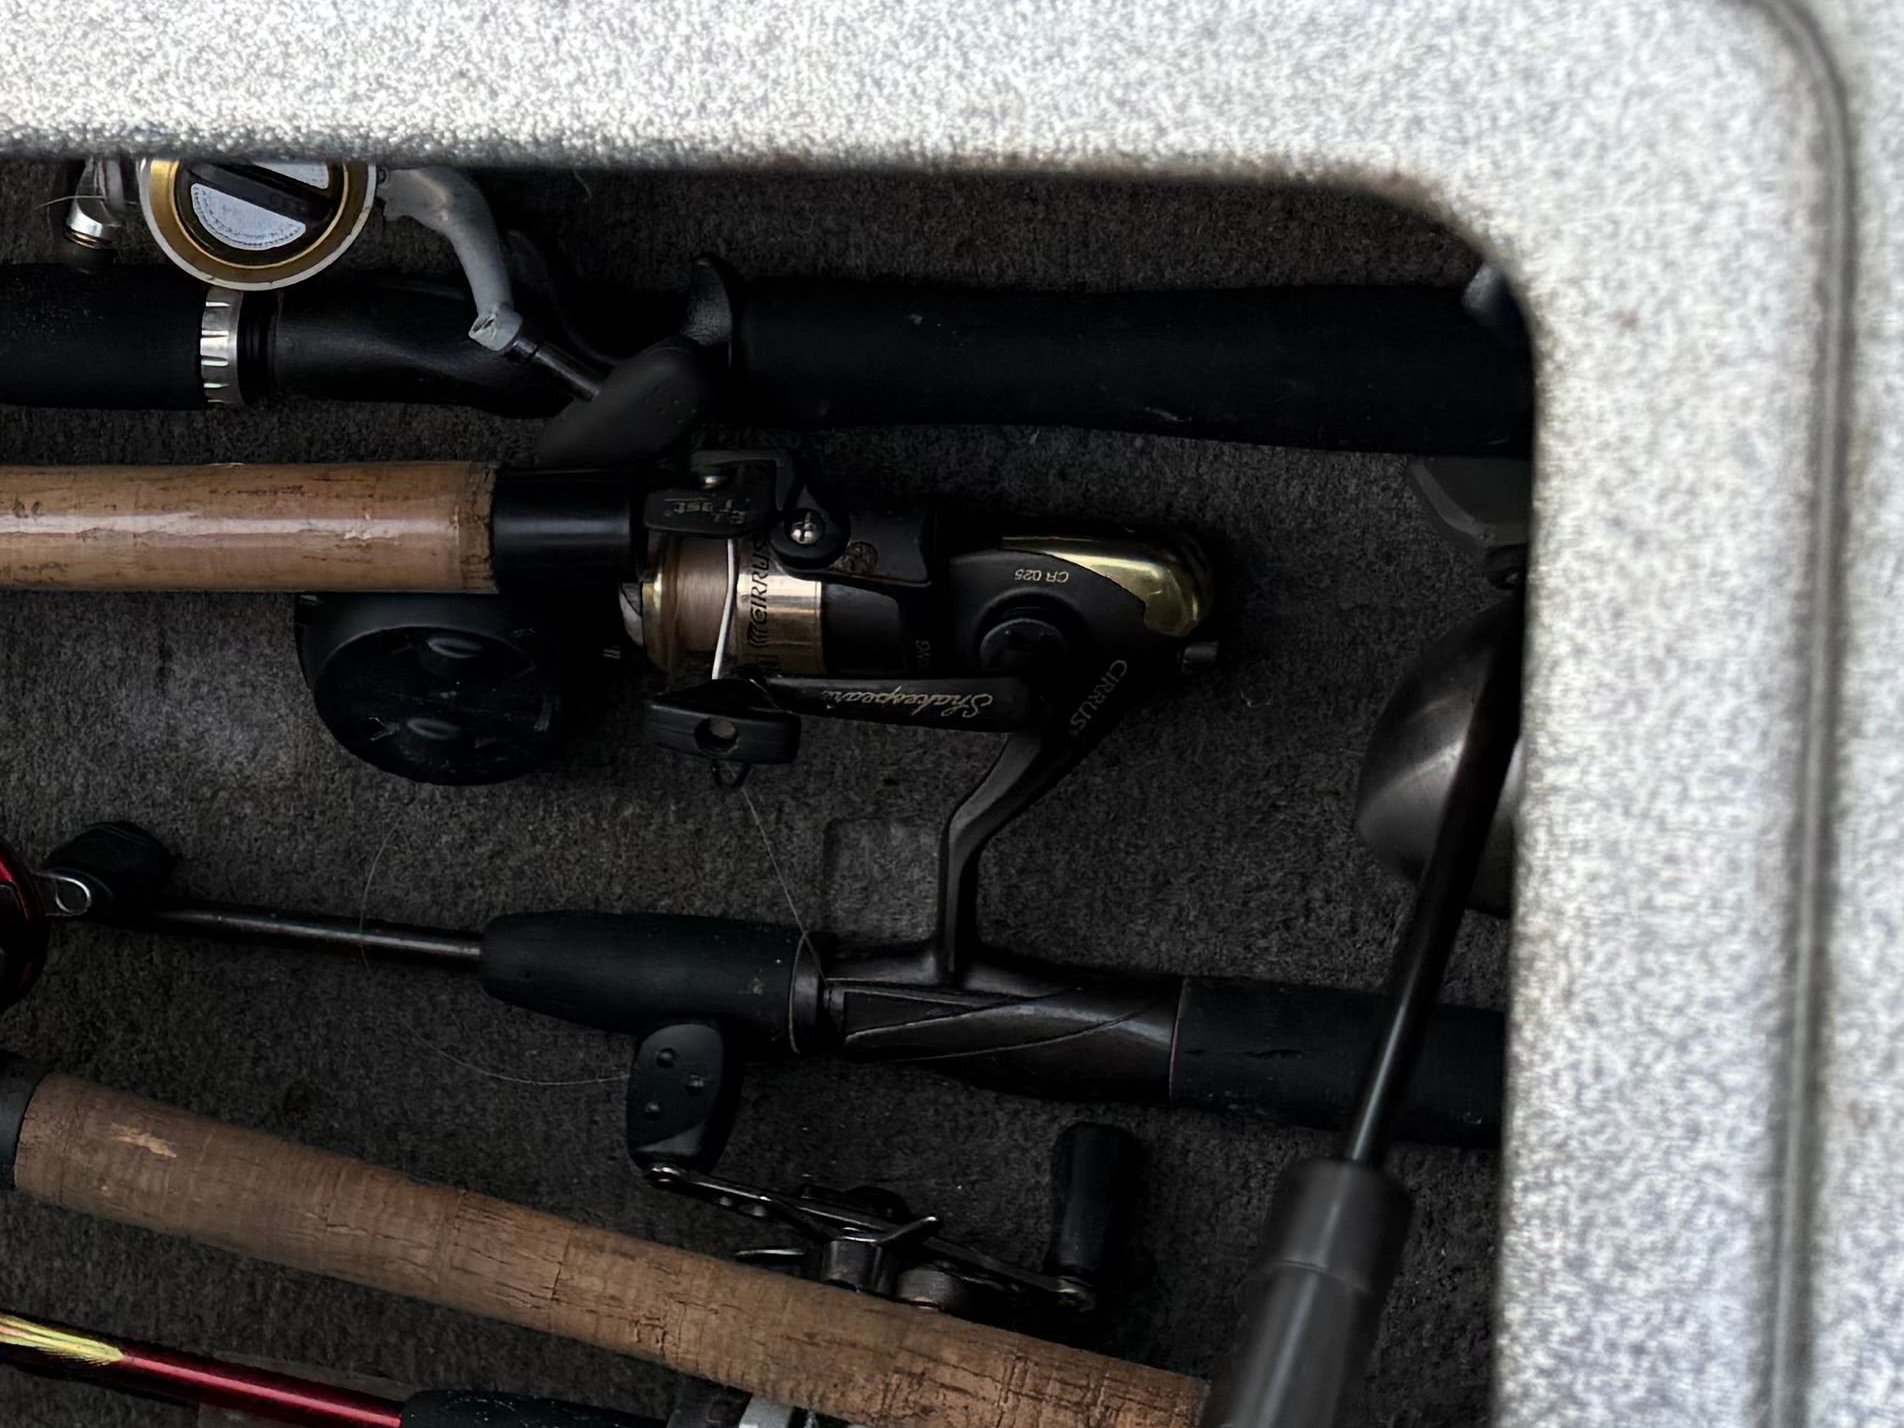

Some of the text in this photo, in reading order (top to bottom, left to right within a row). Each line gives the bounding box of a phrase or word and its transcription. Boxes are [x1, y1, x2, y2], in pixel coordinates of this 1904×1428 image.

[1047, 569, 1069, 582] CR
[821, 689, 993, 719] Shakespeare
[1070, 660, 1128, 732] CIRRUS
